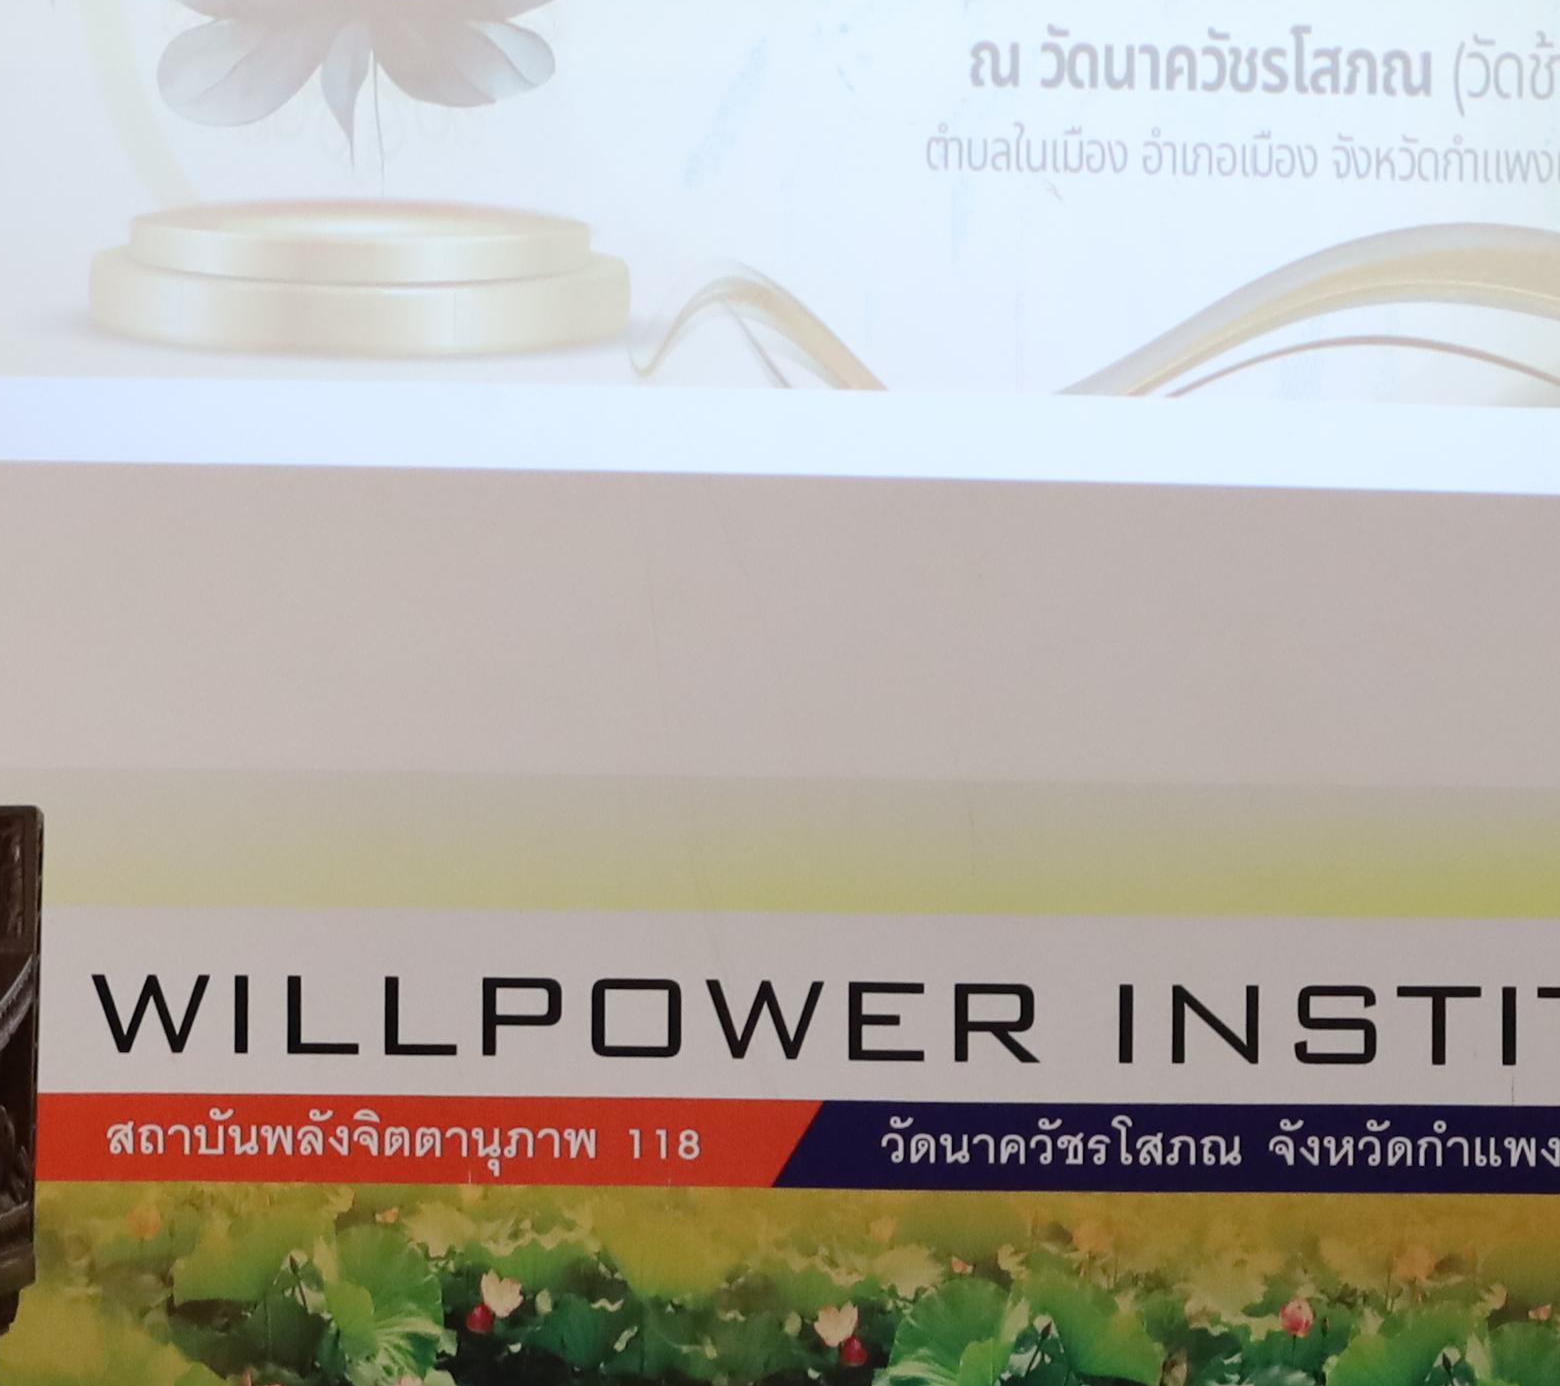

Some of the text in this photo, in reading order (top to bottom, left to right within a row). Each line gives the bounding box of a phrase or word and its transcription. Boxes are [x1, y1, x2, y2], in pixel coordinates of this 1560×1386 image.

[969, 40, 1021, 89] ณ
[1039, 23, 1433, 98] วัดนาควัชรโสภณ
[925, 121, 1129, 175] ตำบลในเมือง
[1142, 126, 1319, 180] อำเภอเมือง
[91, 973, 1040, 1064] WILLPOWER
[106, 1107, 700, 1177] สถาบันพลังจิตตานุภาพ 118
[880, 1114, 1242, 1166] วัดนาควัชรโสภณ
